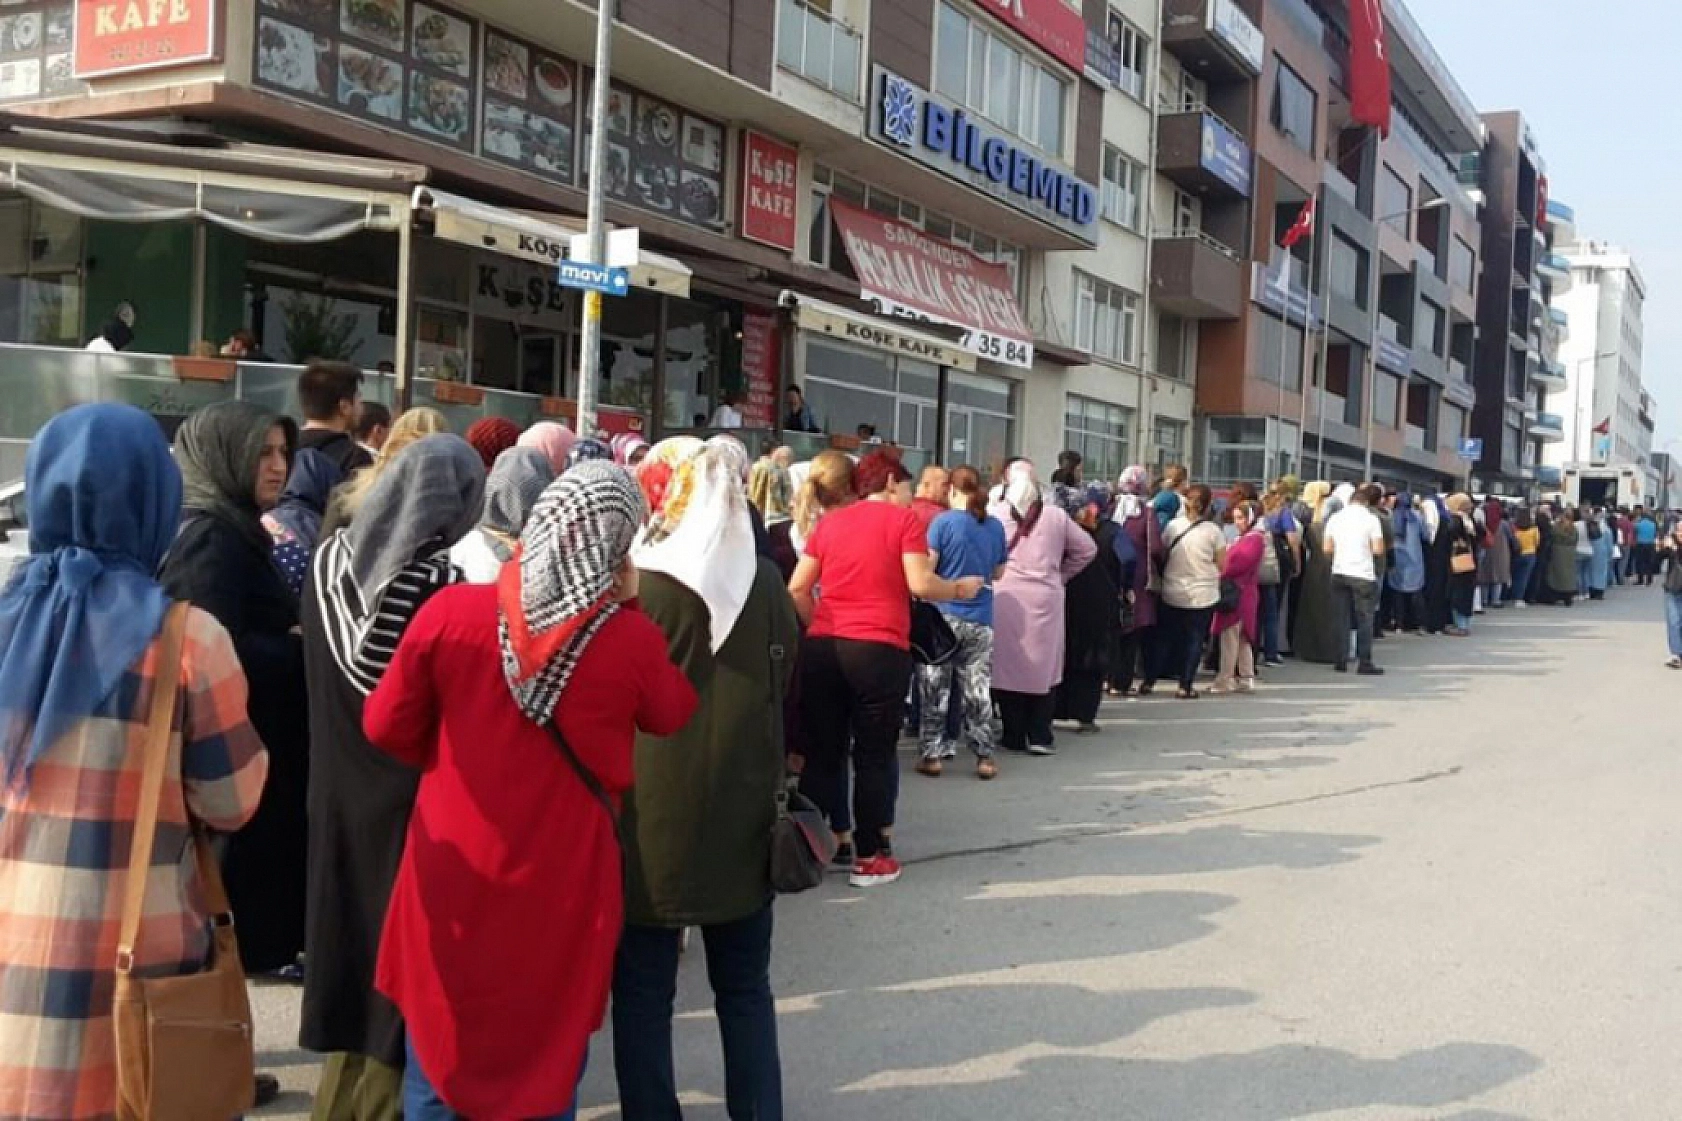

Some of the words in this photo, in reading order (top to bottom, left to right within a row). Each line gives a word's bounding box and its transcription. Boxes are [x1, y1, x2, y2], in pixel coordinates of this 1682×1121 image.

[94, 0, 192, 37] KAFE
[924, 100, 1096, 226] BİLGEMED
[751, 185, 793, 220] KAFE
[561, 264, 609, 285] mavi
[899, 336, 943, 360] KAFE
[979, 333, 1001, 357] 35
[1006, 340, 1027, 364] 84
